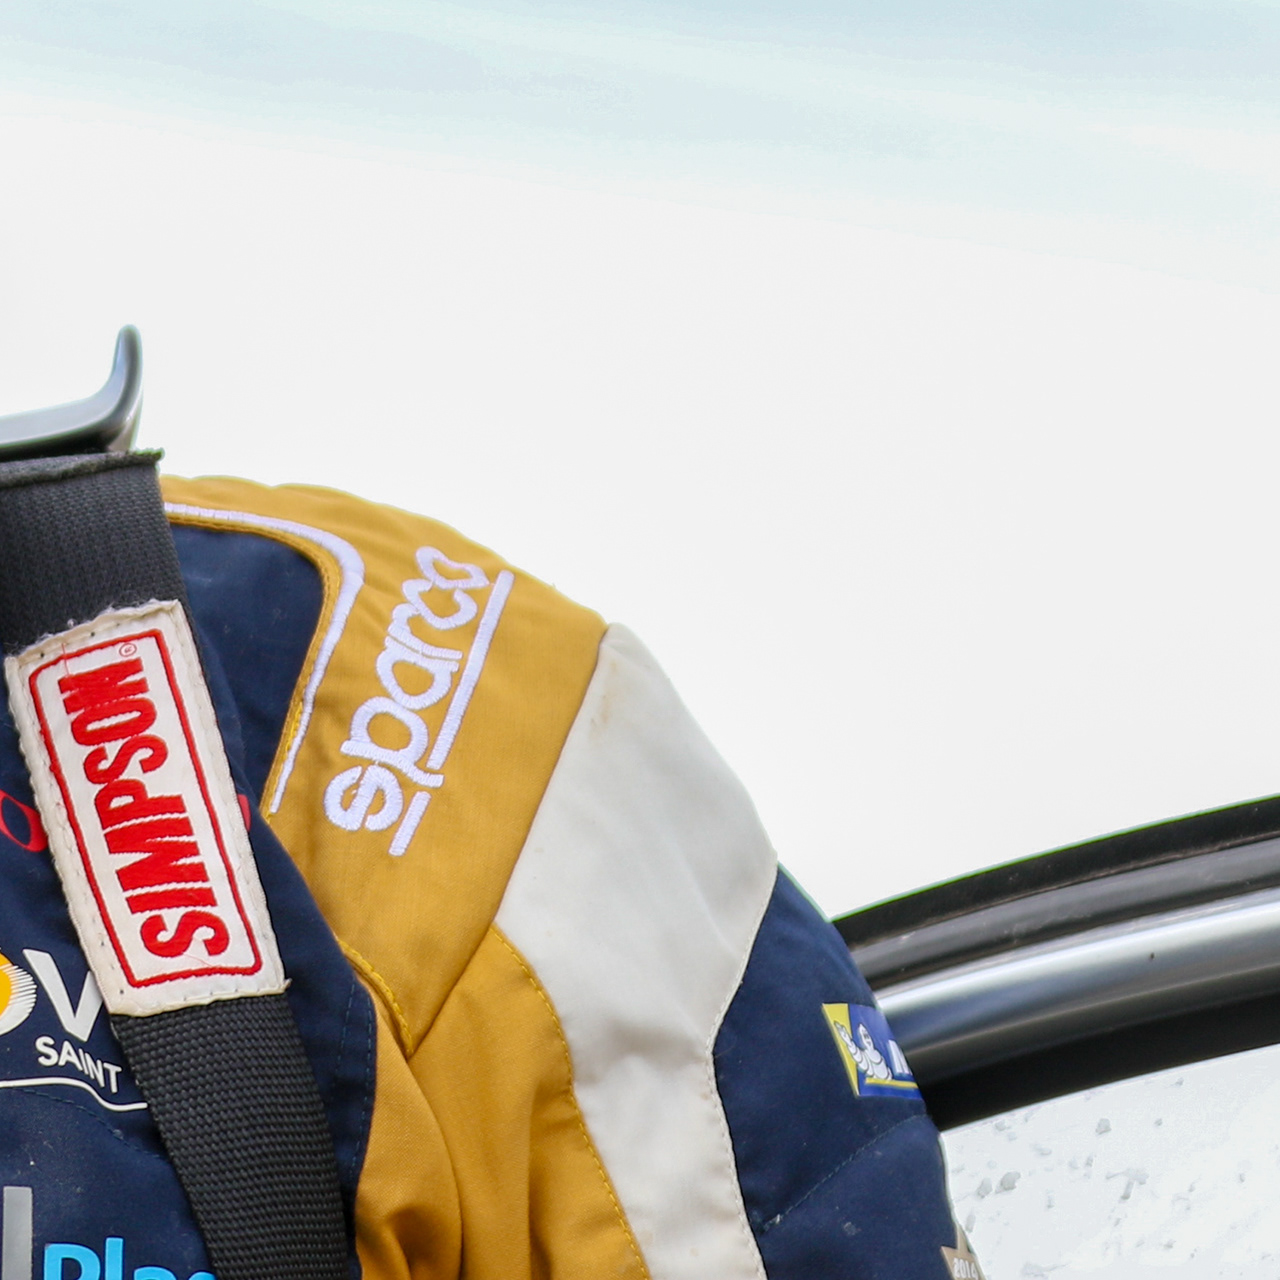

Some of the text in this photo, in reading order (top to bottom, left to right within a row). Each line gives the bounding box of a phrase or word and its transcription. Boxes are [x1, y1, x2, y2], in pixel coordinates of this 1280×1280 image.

[57, 655, 231, 959] SIMPSON
[323, 546, 490, 833] sparco
[35, 1035, 123, 1094] SAINT
